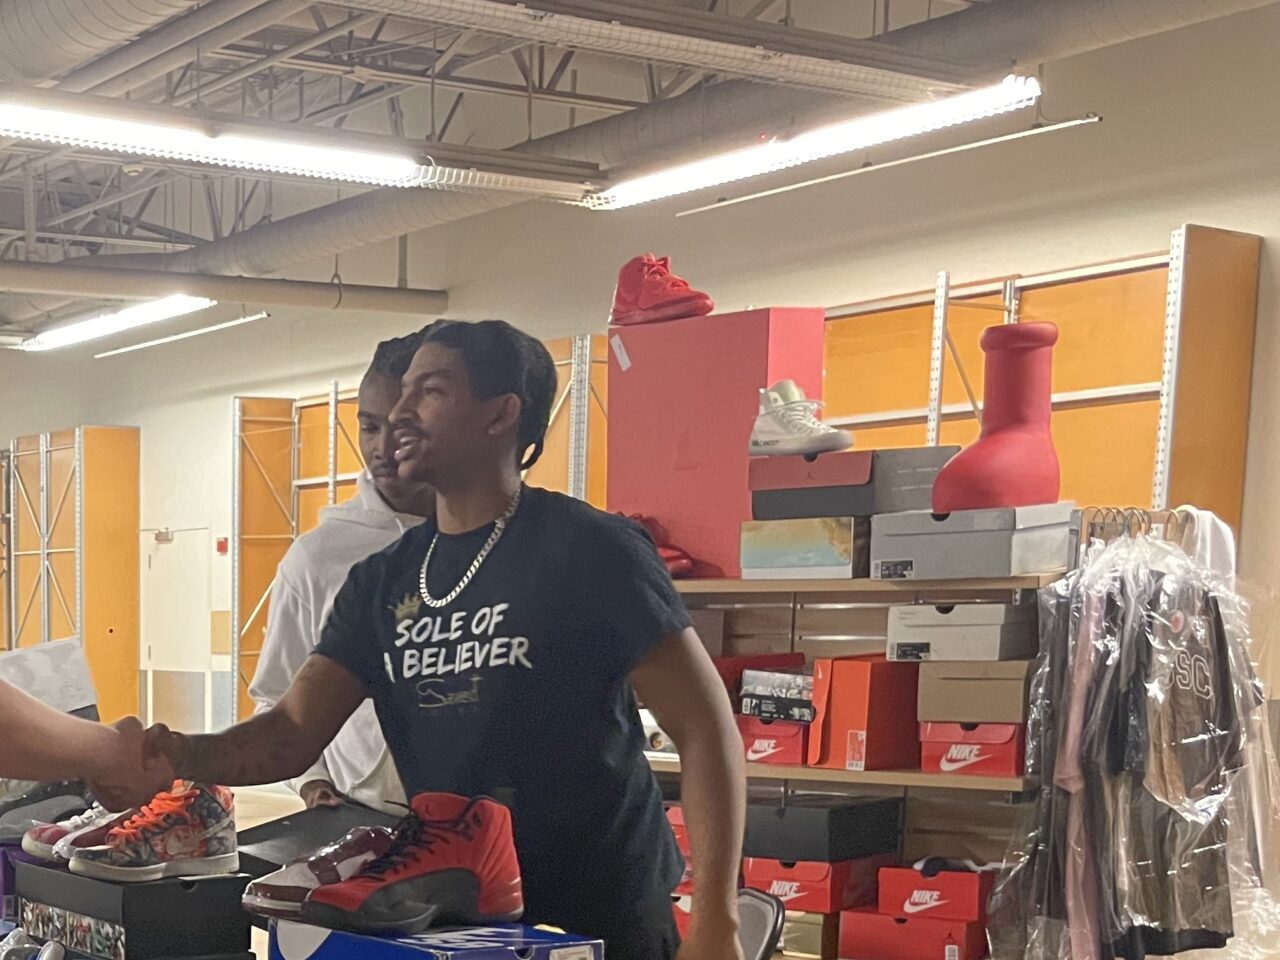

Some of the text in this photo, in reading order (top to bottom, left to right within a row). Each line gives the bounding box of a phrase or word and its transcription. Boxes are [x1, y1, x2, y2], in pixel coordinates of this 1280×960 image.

[394, 602, 510, 648] SOLE OF
[402, 636, 533, 679] BELIEVER
[752, 739, 777, 752] NIKE
[947, 744, 982, 761] NIKE
[770, 880, 800, 897] NIKE
[910, 889, 941, 905] NIKE
